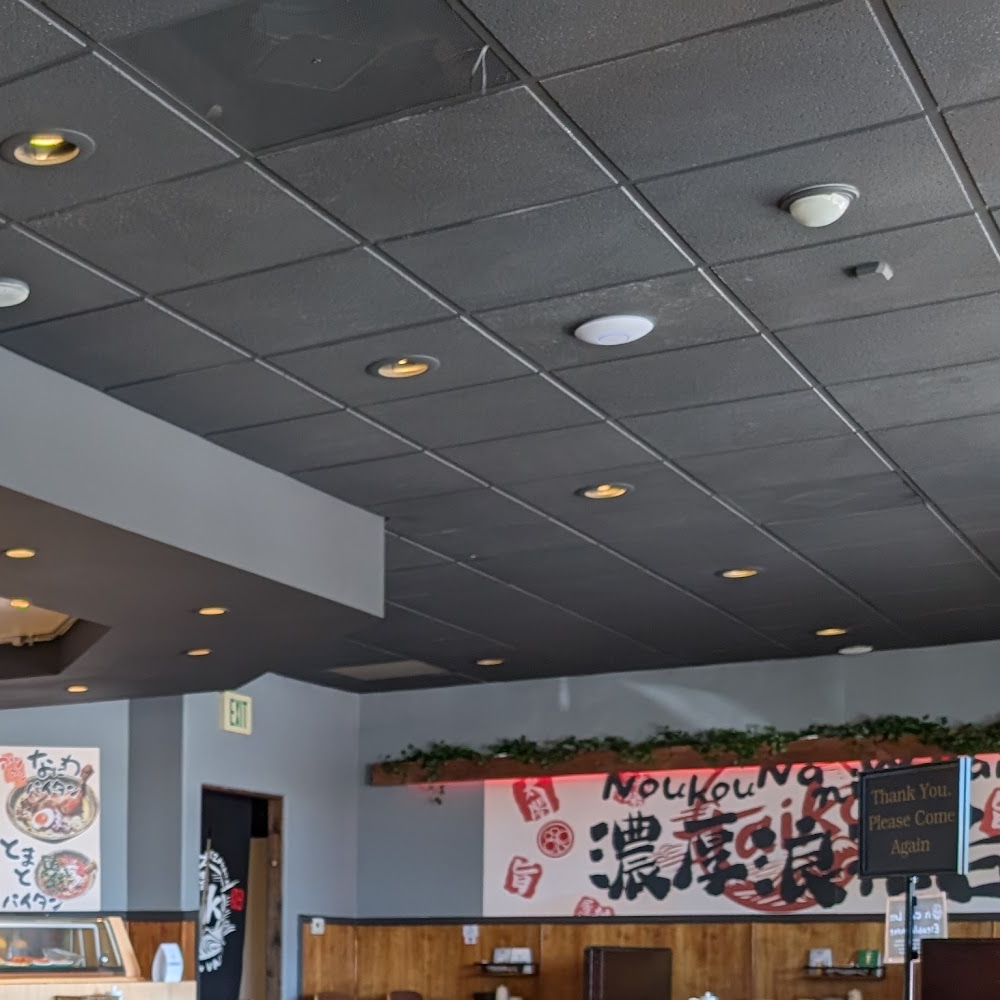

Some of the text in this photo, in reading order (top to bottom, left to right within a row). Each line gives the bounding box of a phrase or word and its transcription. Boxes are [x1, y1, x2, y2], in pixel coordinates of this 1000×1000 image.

[230, 698, 248, 729] EXIT
[602, 772, 755, 806] Noukou
[871, 782, 952, 806] Thank You.
[869, 809, 956, 832] Please Come
[890, 838, 931, 857] Again
